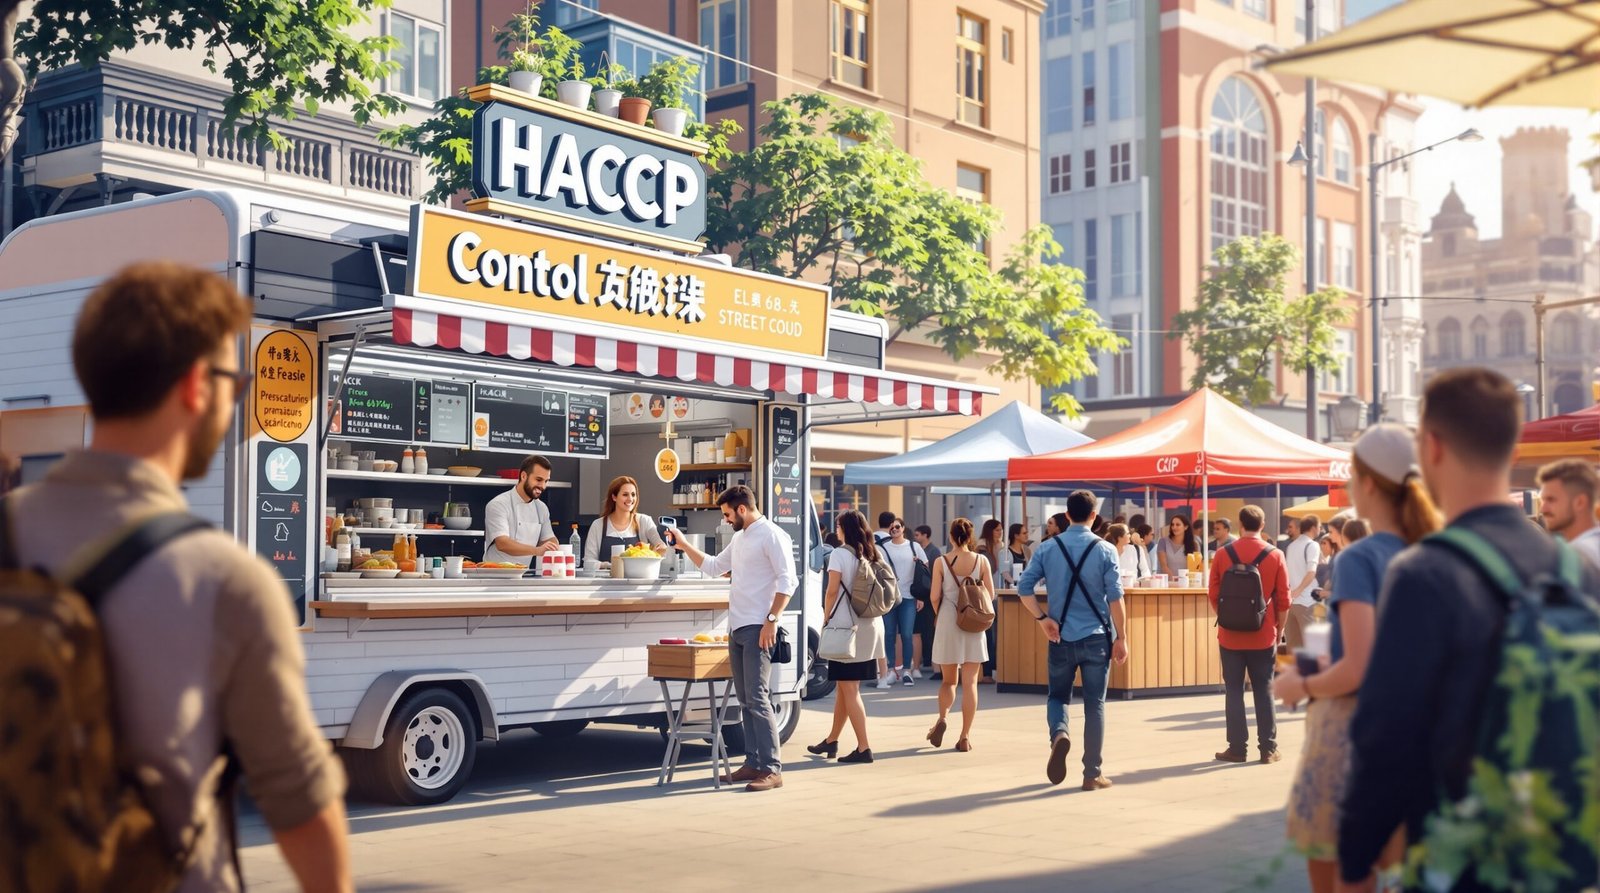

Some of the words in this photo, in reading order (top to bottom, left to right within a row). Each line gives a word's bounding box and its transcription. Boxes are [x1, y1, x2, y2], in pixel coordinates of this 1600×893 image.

[497, 116, 699, 225] HACCP
[449, 231, 589, 303] Contol
[719, 309, 767, 331] STREET
[769, 317, 803, 338] COUD
